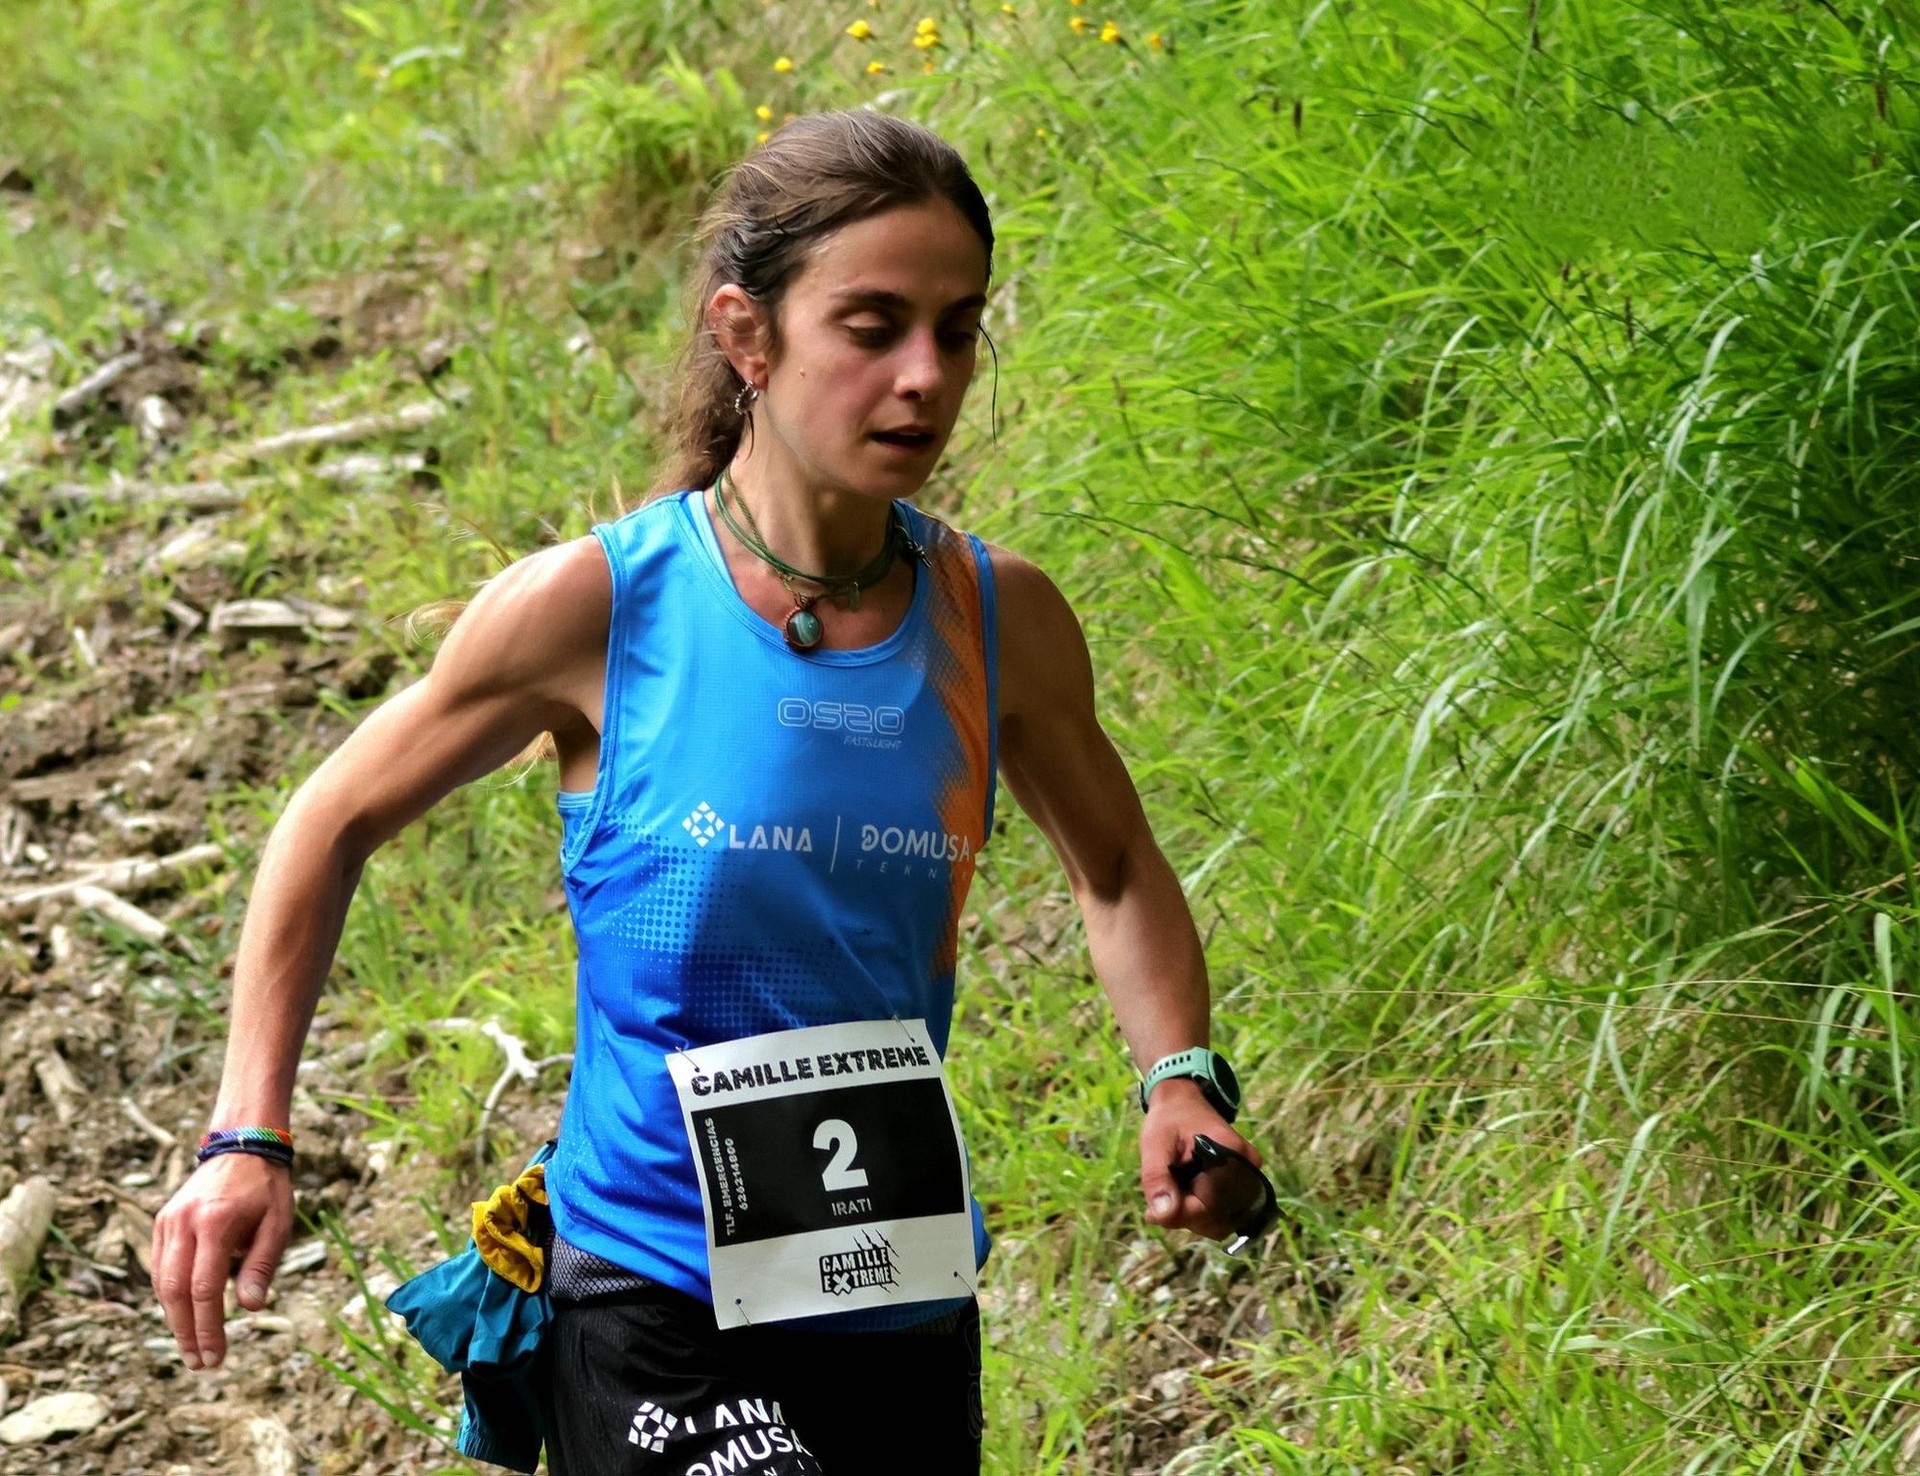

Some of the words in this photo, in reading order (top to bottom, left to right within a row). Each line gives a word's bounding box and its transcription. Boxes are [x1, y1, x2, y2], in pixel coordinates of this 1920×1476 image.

[729, 824, 813, 852] LANA
[861, 824, 970, 862] DOMUSA
[690, 1057, 813, 1096] CAMILLE
[817, 1045, 931, 1078] EXTREME
[705, 1117, 732, 1208] EMERGENCIAS
[812, 1118, 869, 1192] 2
[725, 1207, 736, 1236] TLF.
[832, 1198, 872, 1217] IRATI
[822, 1248, 888, 1273] CAMILLE
[822, 1266, 891, 1296] EXTREME
[686, 1426, 813, 1476] OMUSA
